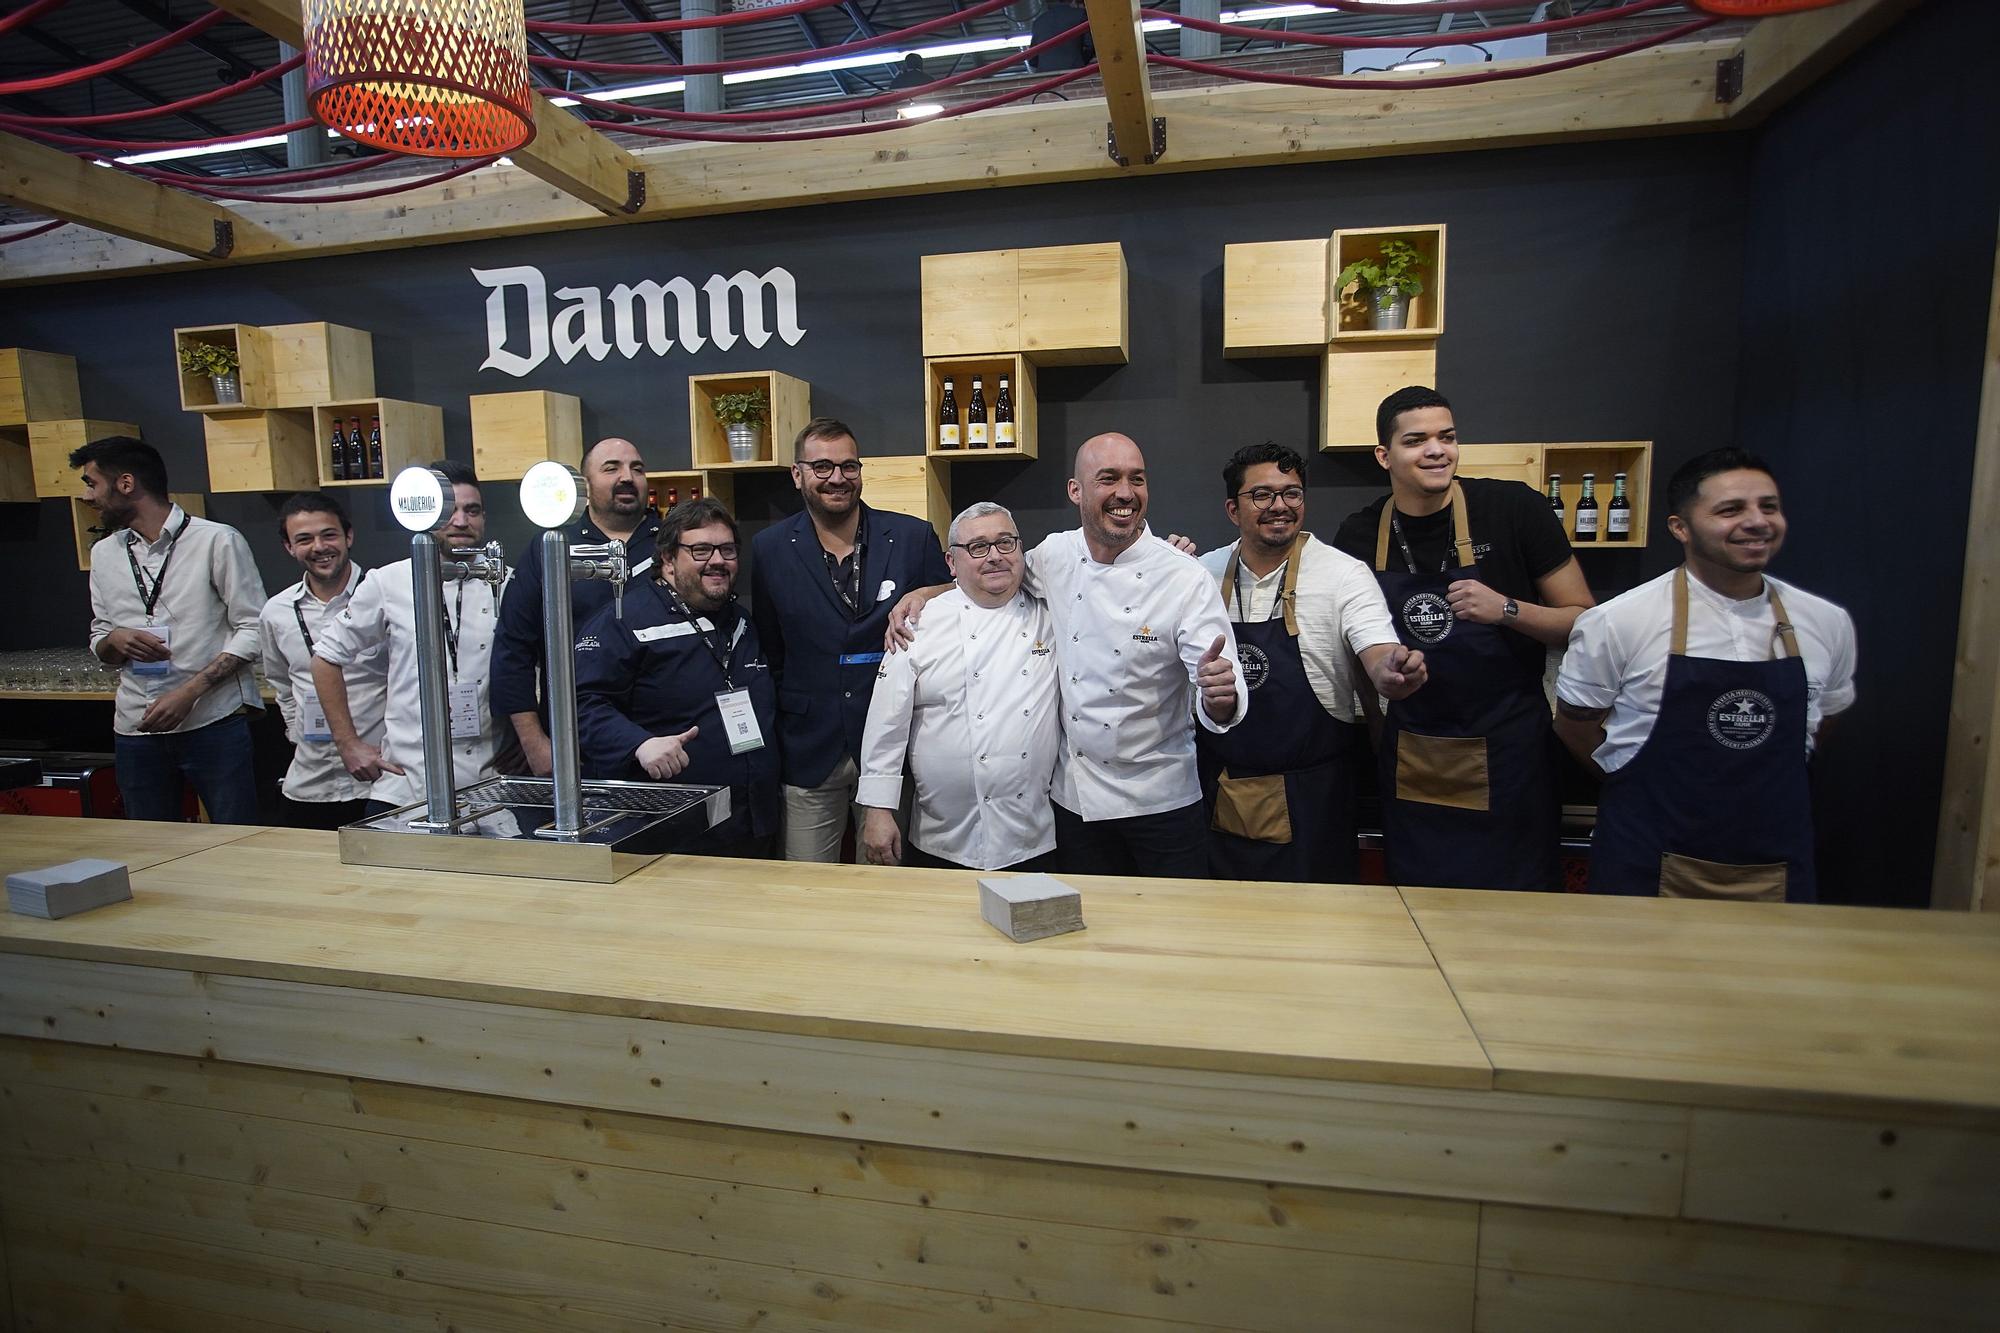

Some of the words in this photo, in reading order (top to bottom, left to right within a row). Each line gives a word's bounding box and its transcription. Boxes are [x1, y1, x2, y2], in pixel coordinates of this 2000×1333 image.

[470, 265, 807, 378] Damm
[398, 495, 436, 511] MALQUERIDA
[1409, 613, 1445, 622] ESTRELLA
[1131, 634, 1159, 642] ESTRELLA
[1719, 713, 1765, 723] ESTRELLA
